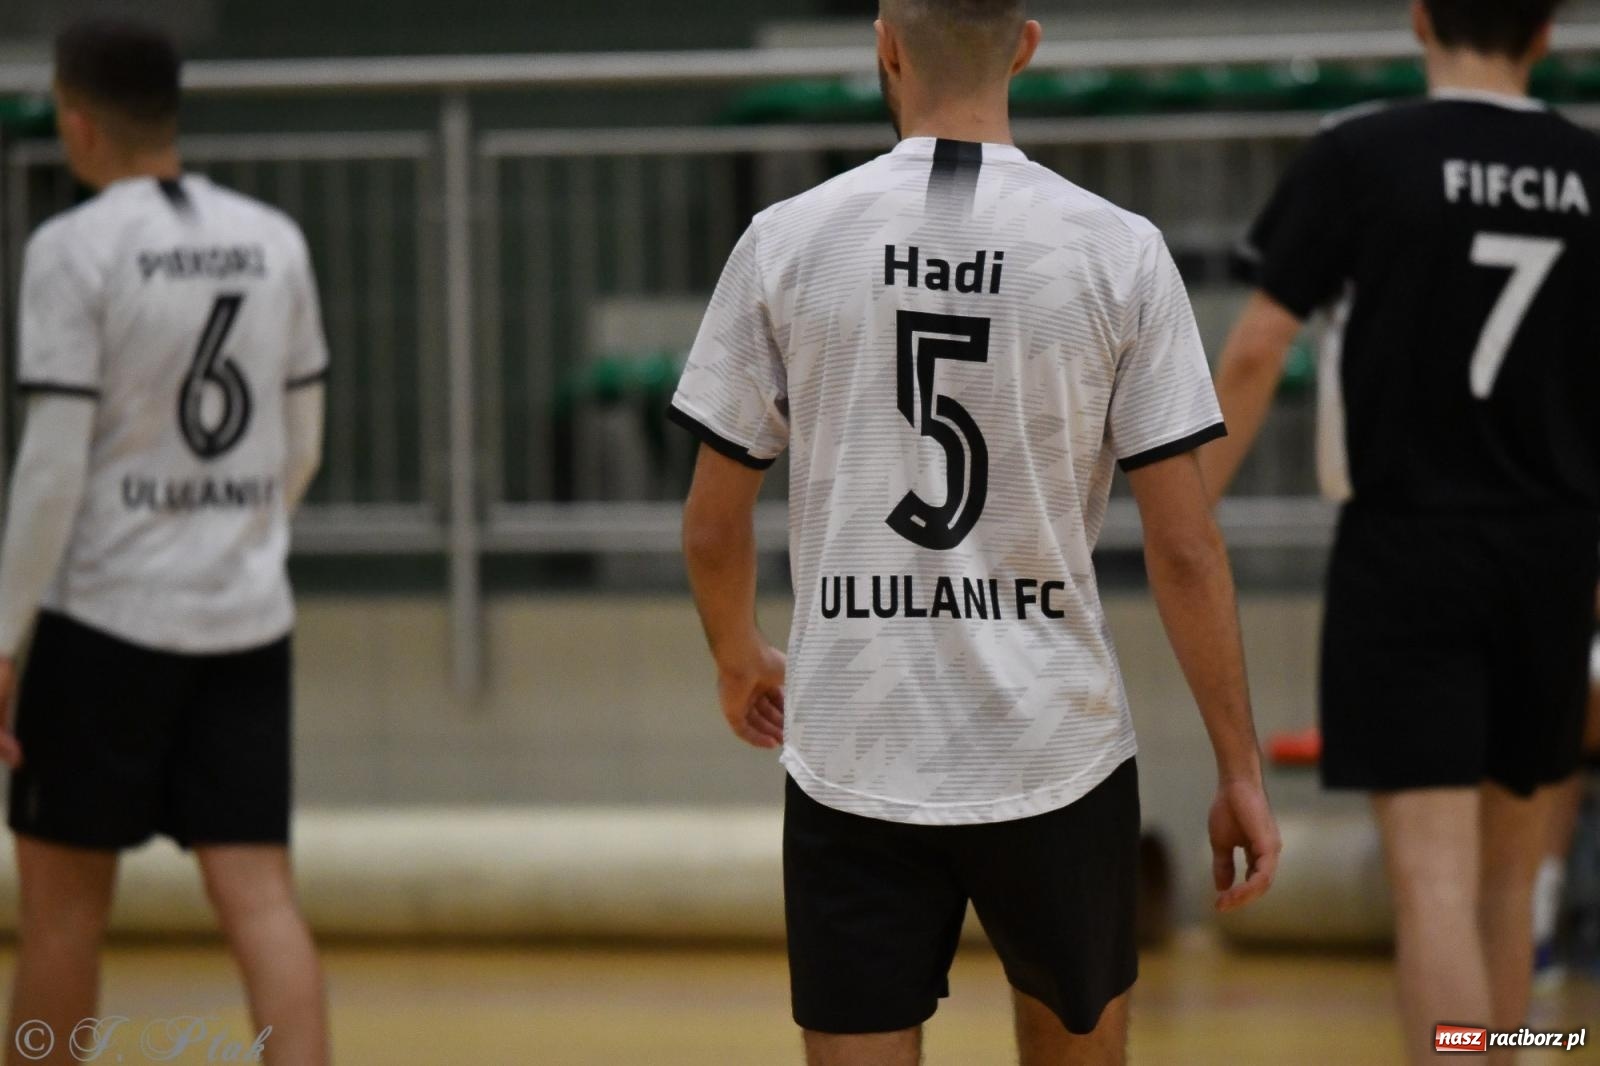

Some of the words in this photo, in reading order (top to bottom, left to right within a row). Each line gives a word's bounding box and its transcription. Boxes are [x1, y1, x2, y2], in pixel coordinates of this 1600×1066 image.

[1443, 159, 1590, 216] FIFCIA
[884, 244, 1004, 294] Hadi
[1469, 231, 1565, 400] 7
[178, 293, 251, 461] 6
[885, 309, 990, 550] 5
[821, 575, 1002, 620] ULULANI
[1014, 578, 1066, 619] FC
